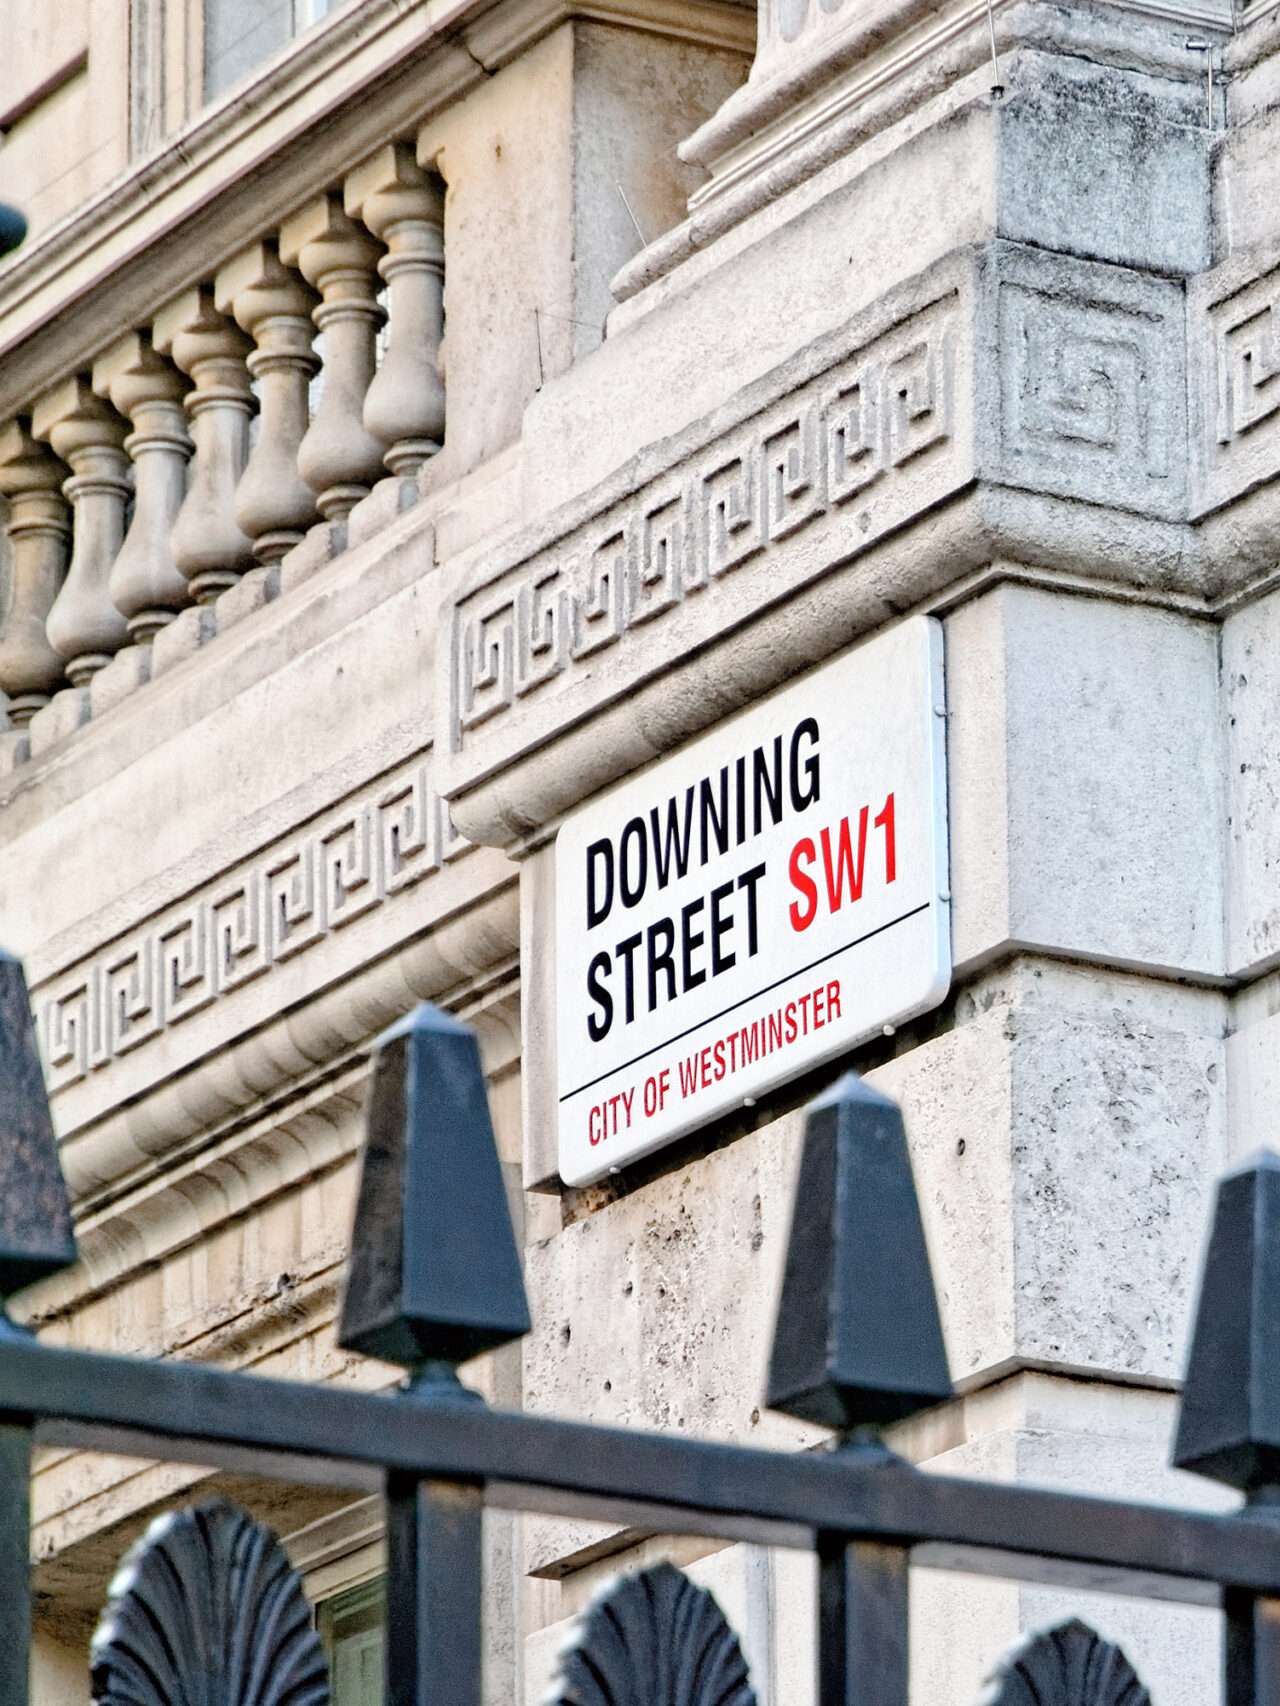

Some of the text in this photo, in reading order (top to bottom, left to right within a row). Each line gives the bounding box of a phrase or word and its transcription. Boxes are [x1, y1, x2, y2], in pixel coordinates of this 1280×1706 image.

[585, 716, 822, 931] DOWNING
[586, 791, 898, 1044] STREET SW1
[588, 978, 843, 1147] CITY OF WESTMINSTER
